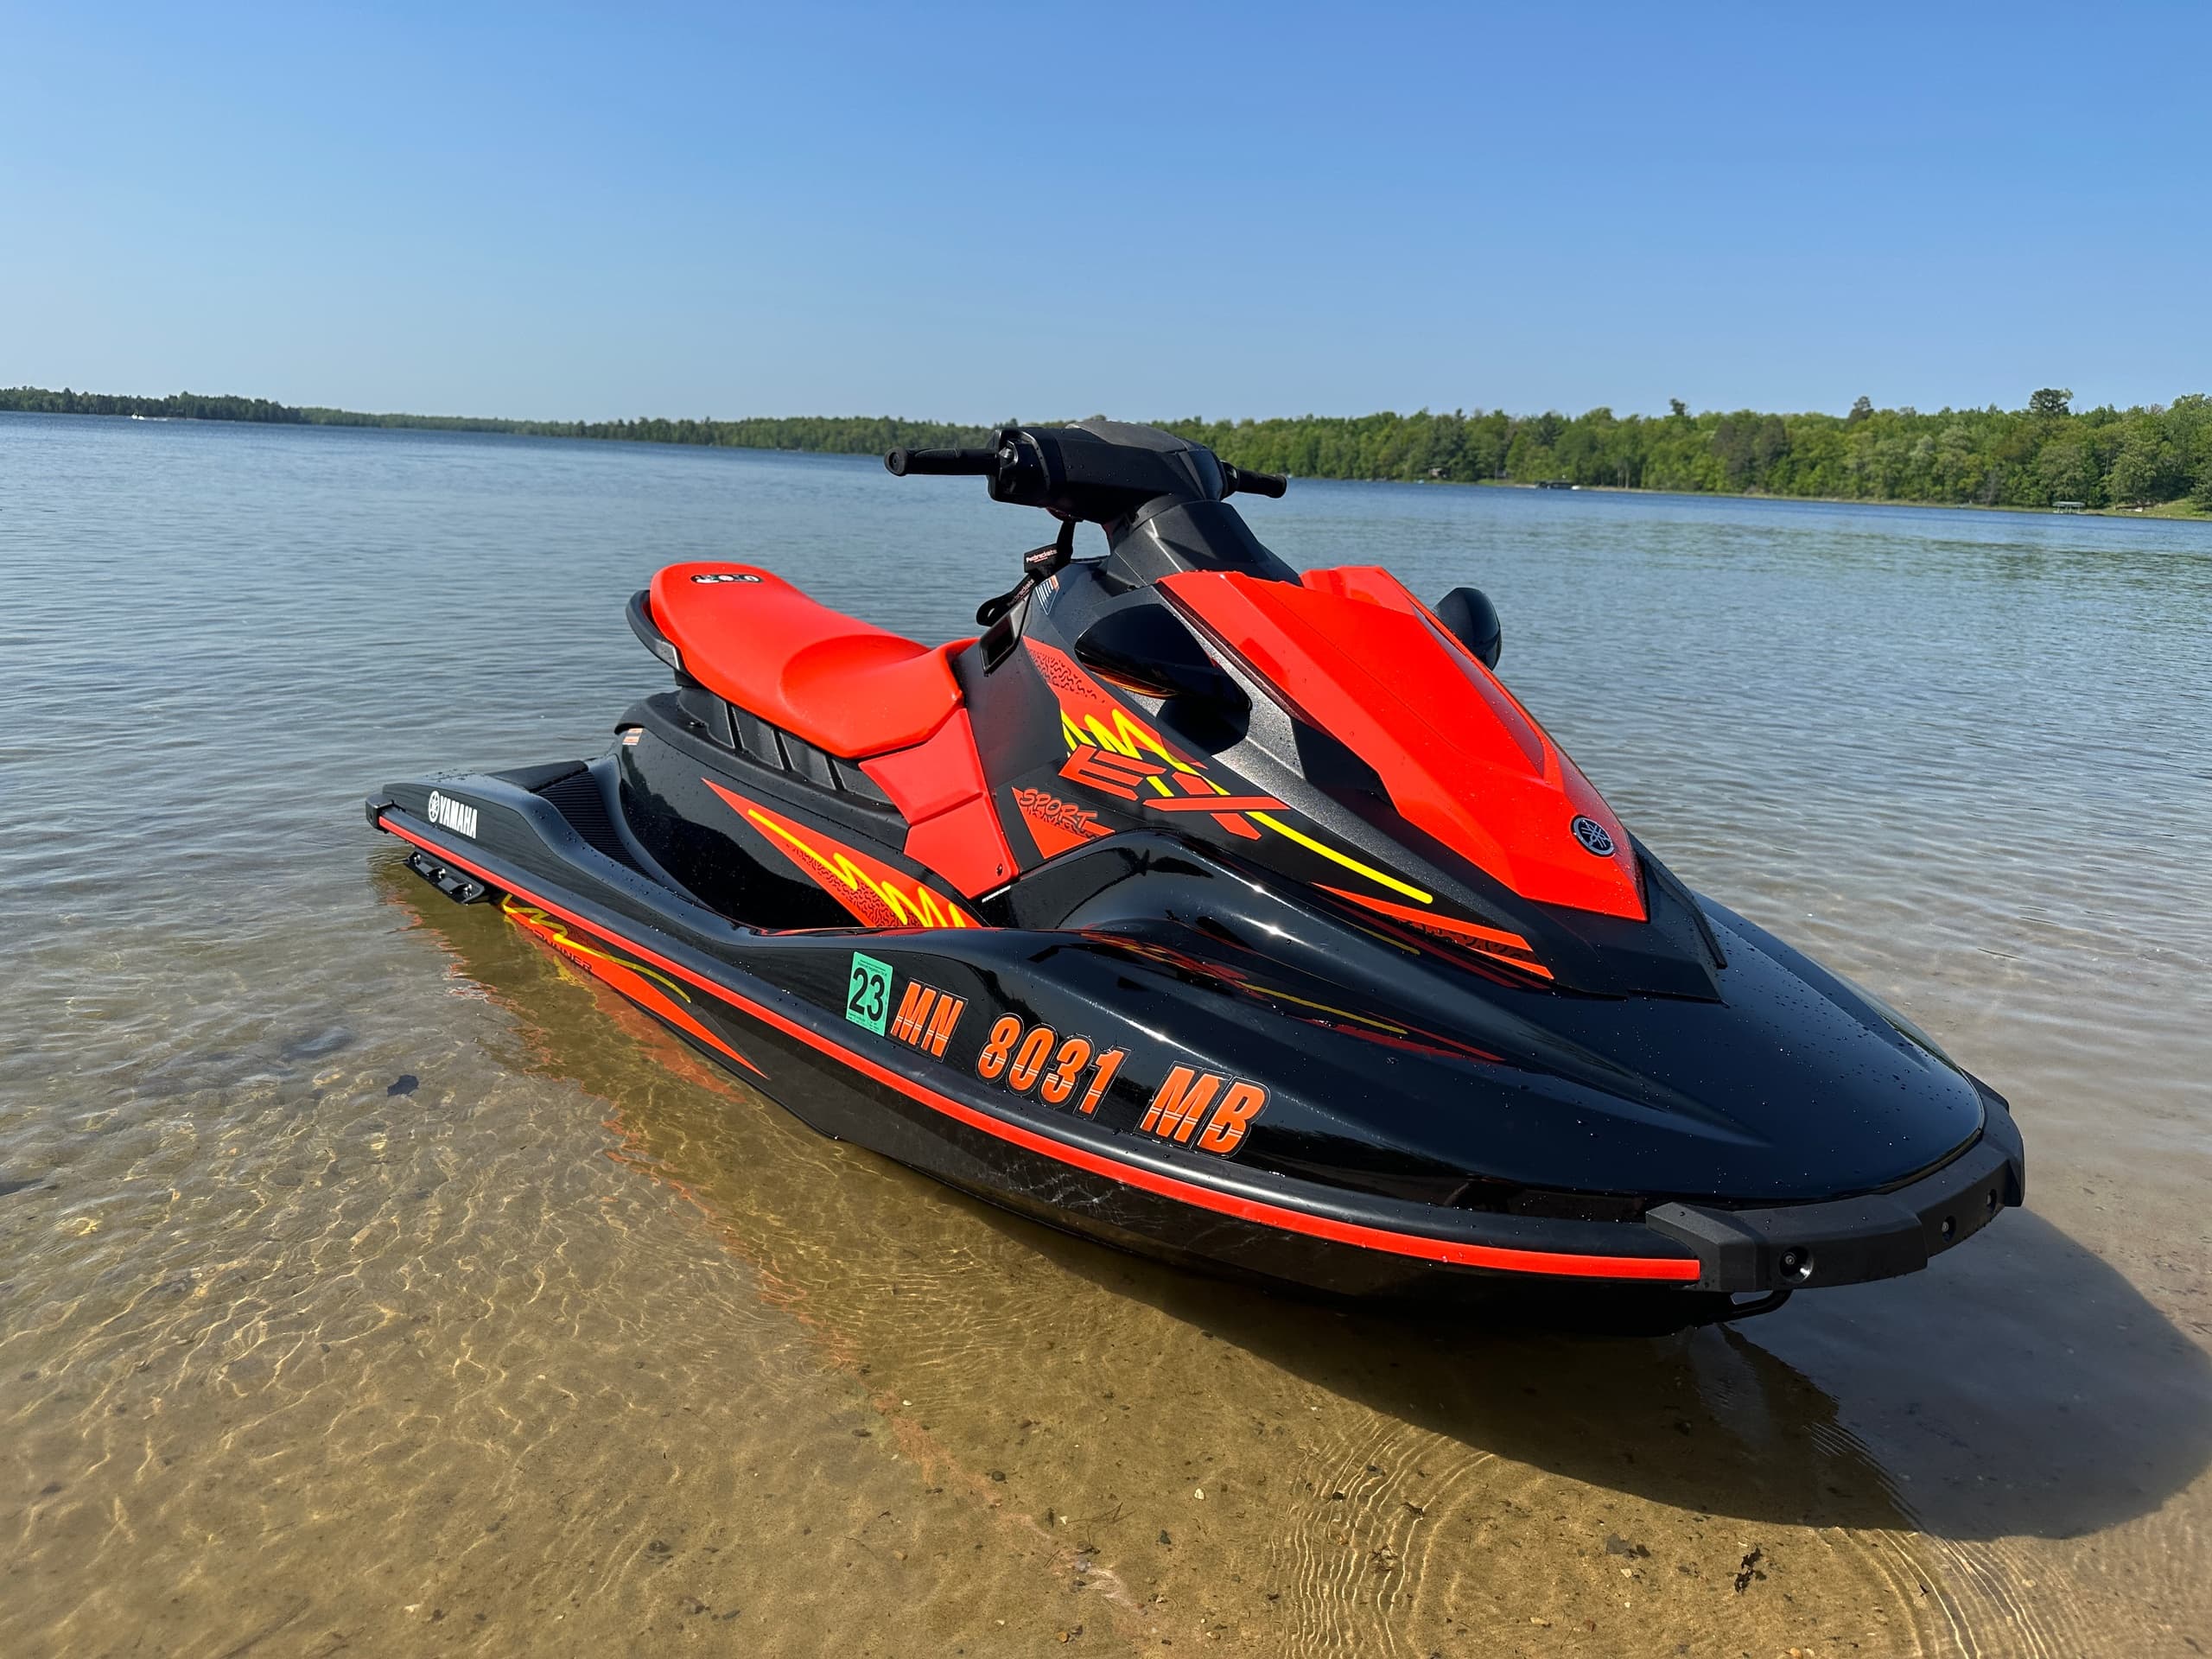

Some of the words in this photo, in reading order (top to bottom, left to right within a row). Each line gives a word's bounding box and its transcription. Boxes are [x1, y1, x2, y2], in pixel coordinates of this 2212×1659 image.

[439, 795, 478, 839] YAMAHA
[1020, 787, 1098, 830] SPORT
[1058, 744, 1291, 841] EX
[849, 967, 885, 1021] 23
[890, 982, 964, 1058] MN
[977, 1016, 1124, 1115] 8031
[1140, 1065, 1267, 1154] MB
